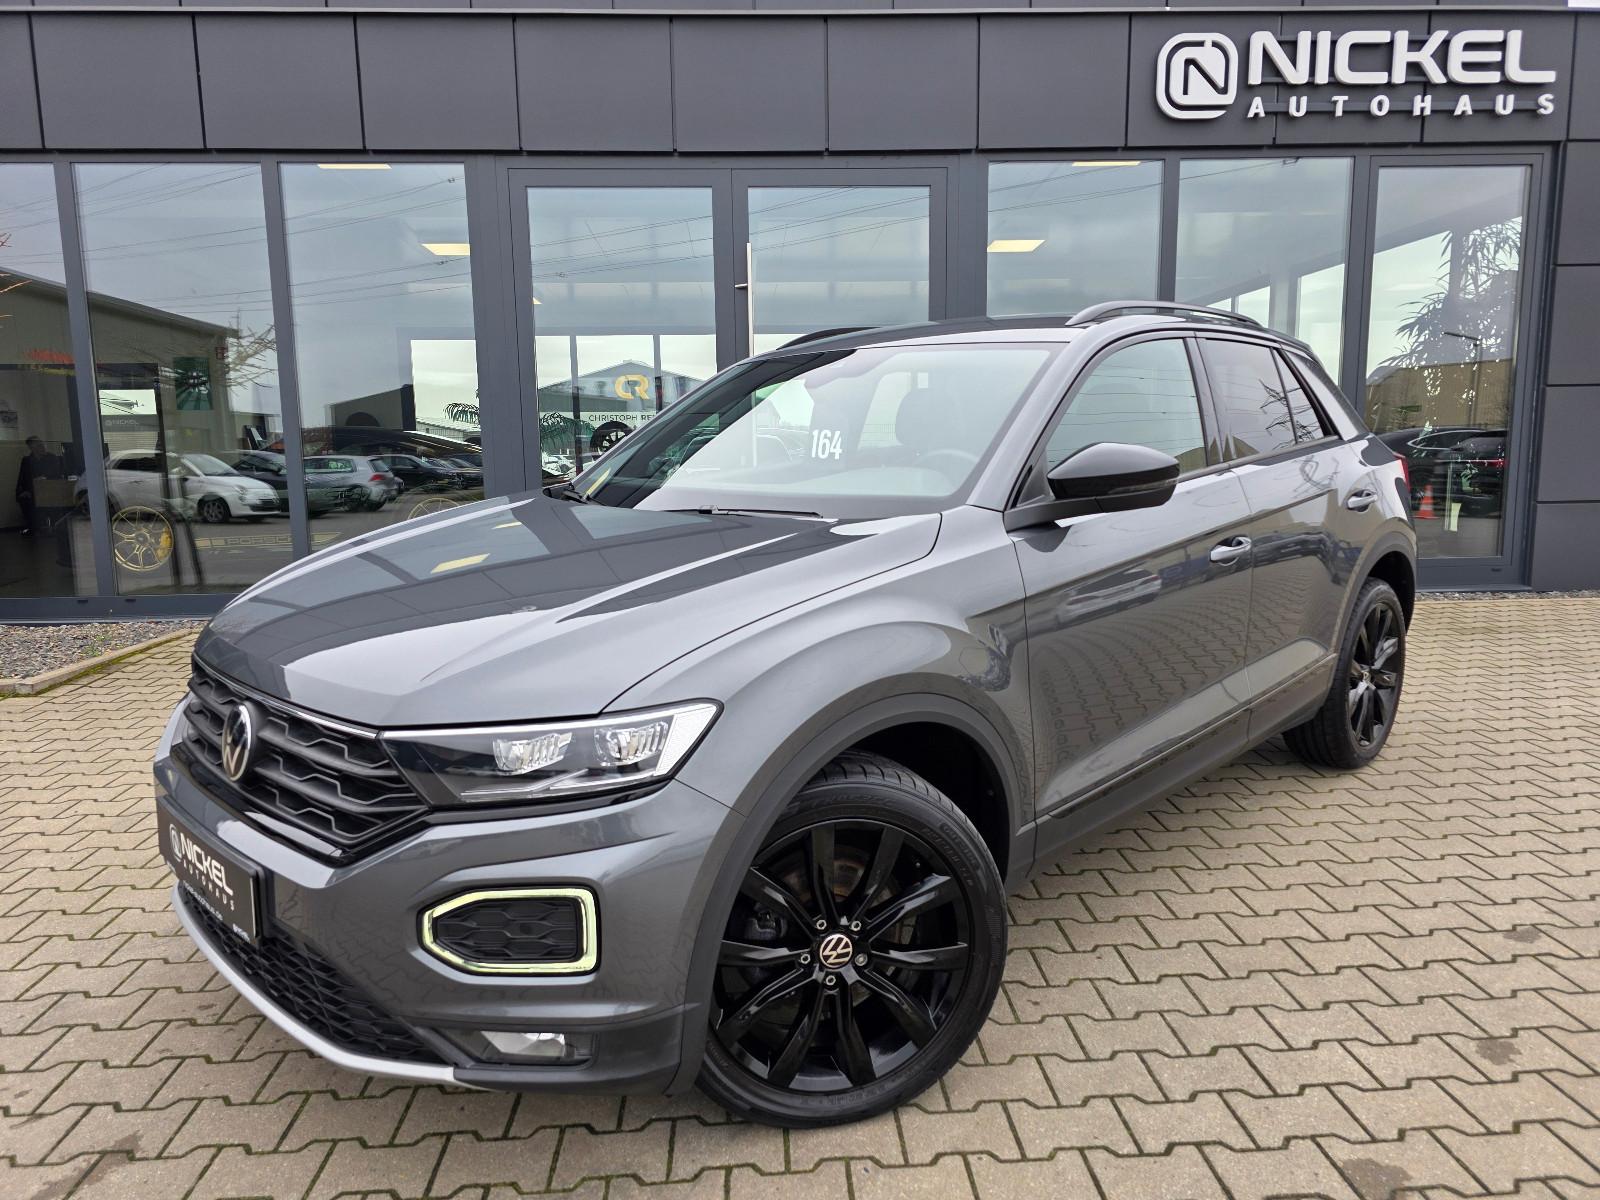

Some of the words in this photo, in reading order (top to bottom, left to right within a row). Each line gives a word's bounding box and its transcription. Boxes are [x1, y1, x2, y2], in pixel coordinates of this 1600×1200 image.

[1247, 29, 1557, 86] NICKEL
[1247, 93, 1555, 119] AUTOHAUS
[588, 414, 638, 422] CHRISTOPH
[811, 429, 843, 460] 164
[180, 832, 234, 897] NICKEL
[183, 859, 236, 912] AUTOHAUS
